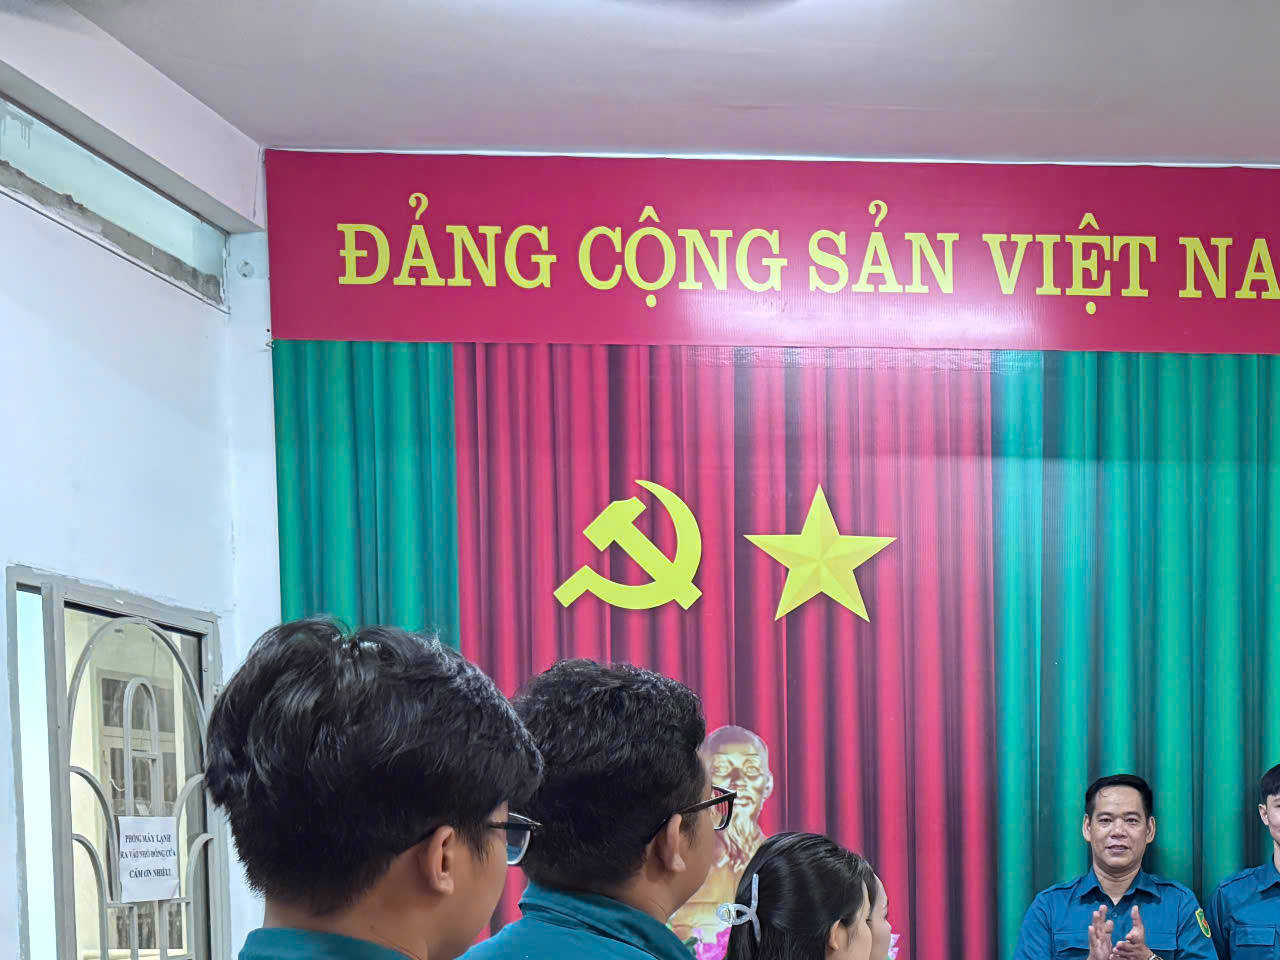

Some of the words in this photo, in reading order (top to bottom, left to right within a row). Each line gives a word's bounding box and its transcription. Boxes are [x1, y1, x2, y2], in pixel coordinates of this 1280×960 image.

[338, 194, 556, 288] ĐẢNG
[579, 207, 786, 307] CỘNG
[810, 201, 958, 289] SẢN
[984, 214, 1156, 314] VIỆT
[156, 834, 171, 845] LẠNH
